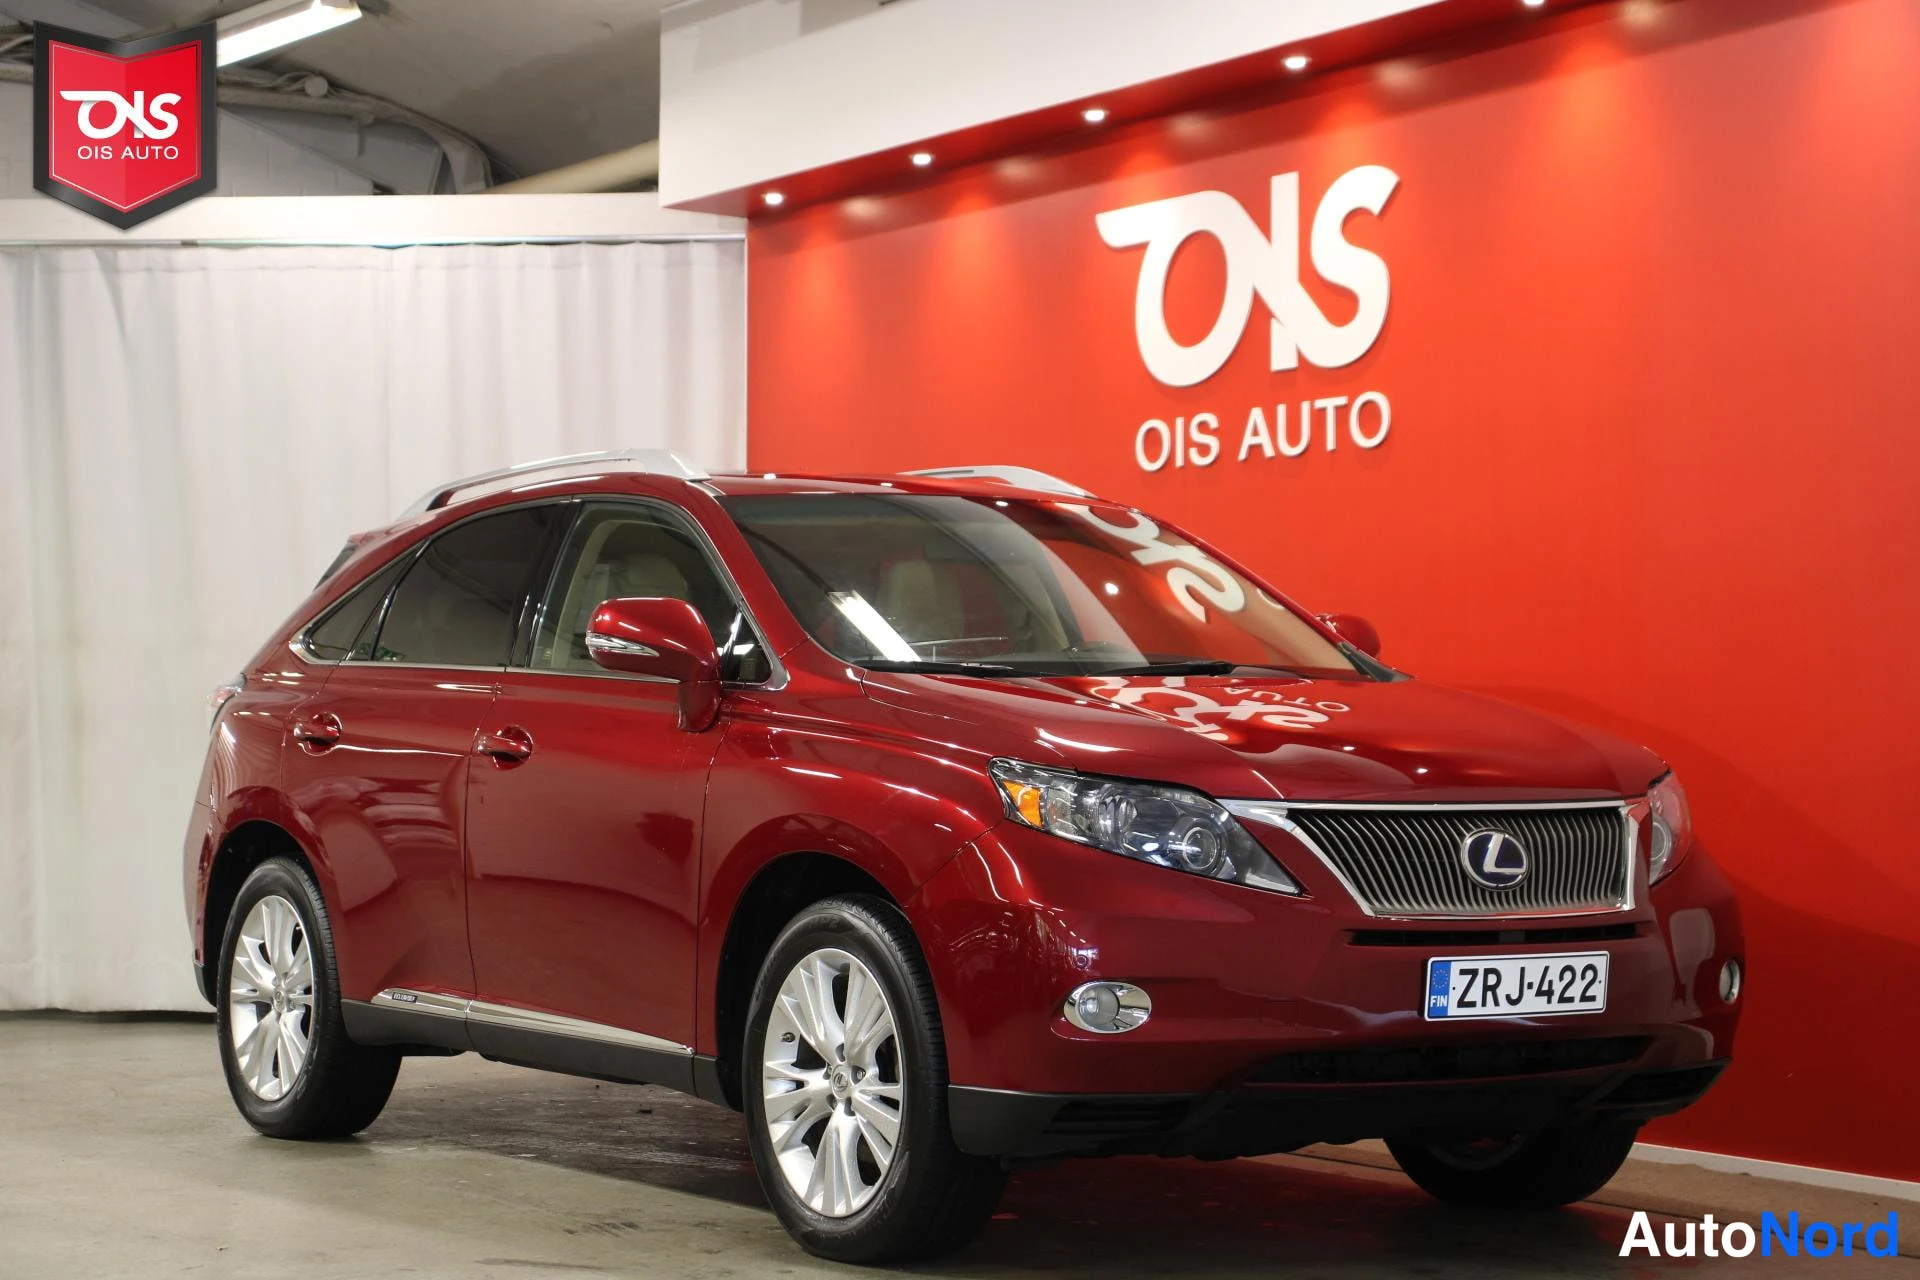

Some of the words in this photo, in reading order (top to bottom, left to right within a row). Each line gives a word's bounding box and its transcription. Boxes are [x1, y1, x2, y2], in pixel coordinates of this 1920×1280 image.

[1095, 165, 1400, 388] OIS
[1135, 412, 1220, 473] OIS
[1238, 391, 1392, 462] AUTO
[1430, 994, 1448, 1008] FIN
[1457, 964, 1598, 1008] ZRJ-422
